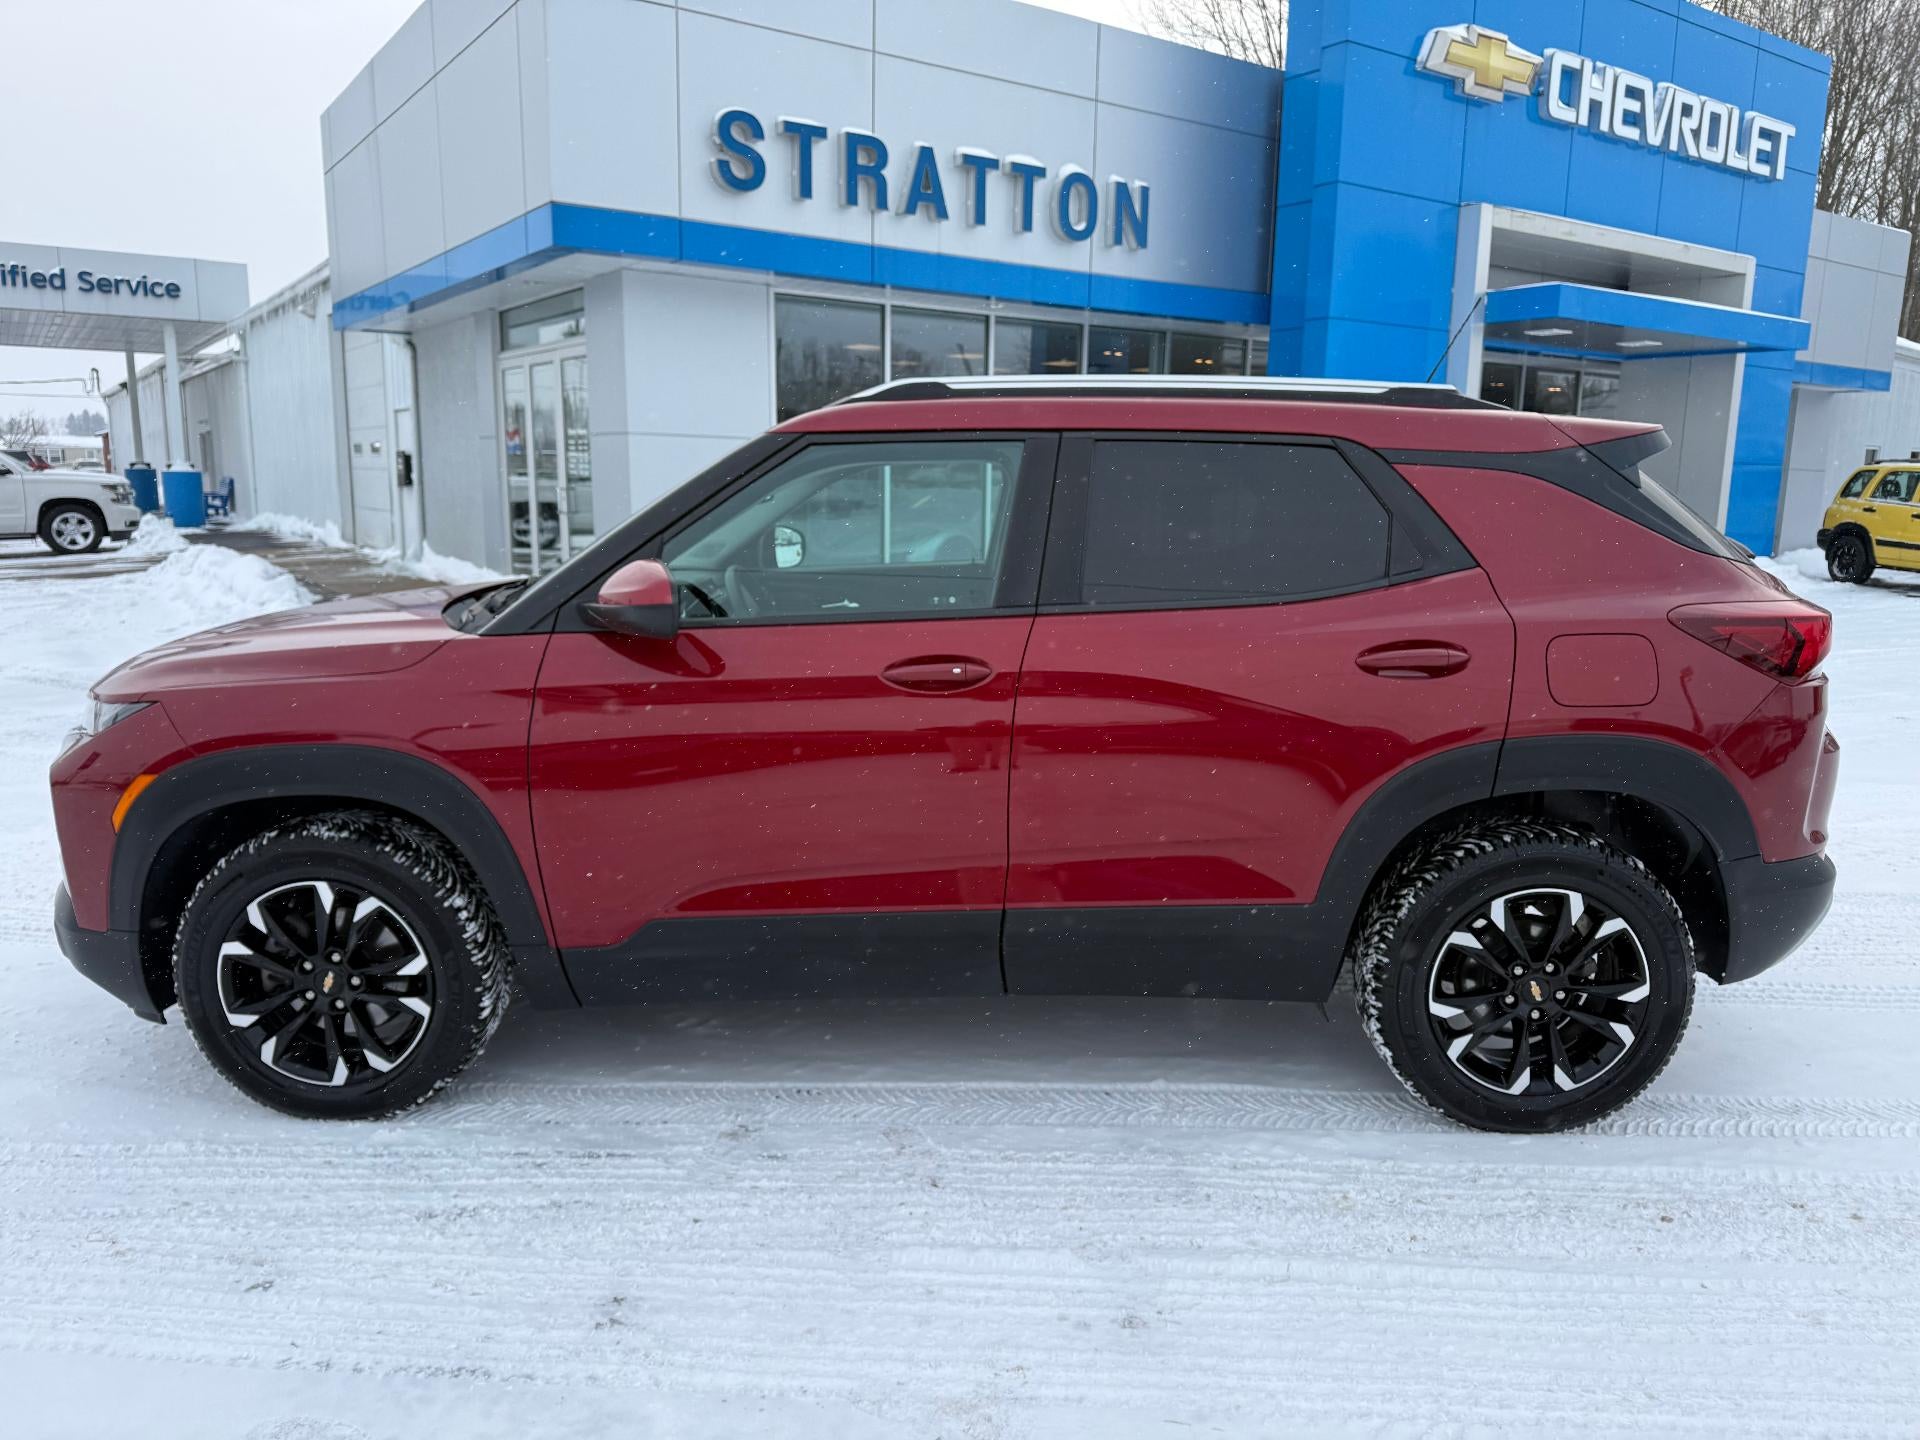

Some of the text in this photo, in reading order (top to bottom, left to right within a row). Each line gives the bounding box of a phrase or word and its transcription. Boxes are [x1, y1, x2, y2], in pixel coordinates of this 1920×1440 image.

[712, 108, 1150, 249] STRATTON
[1542, 49, 1796, 181] CHEVROLET
[0, 263, 181, 298] ified Service
